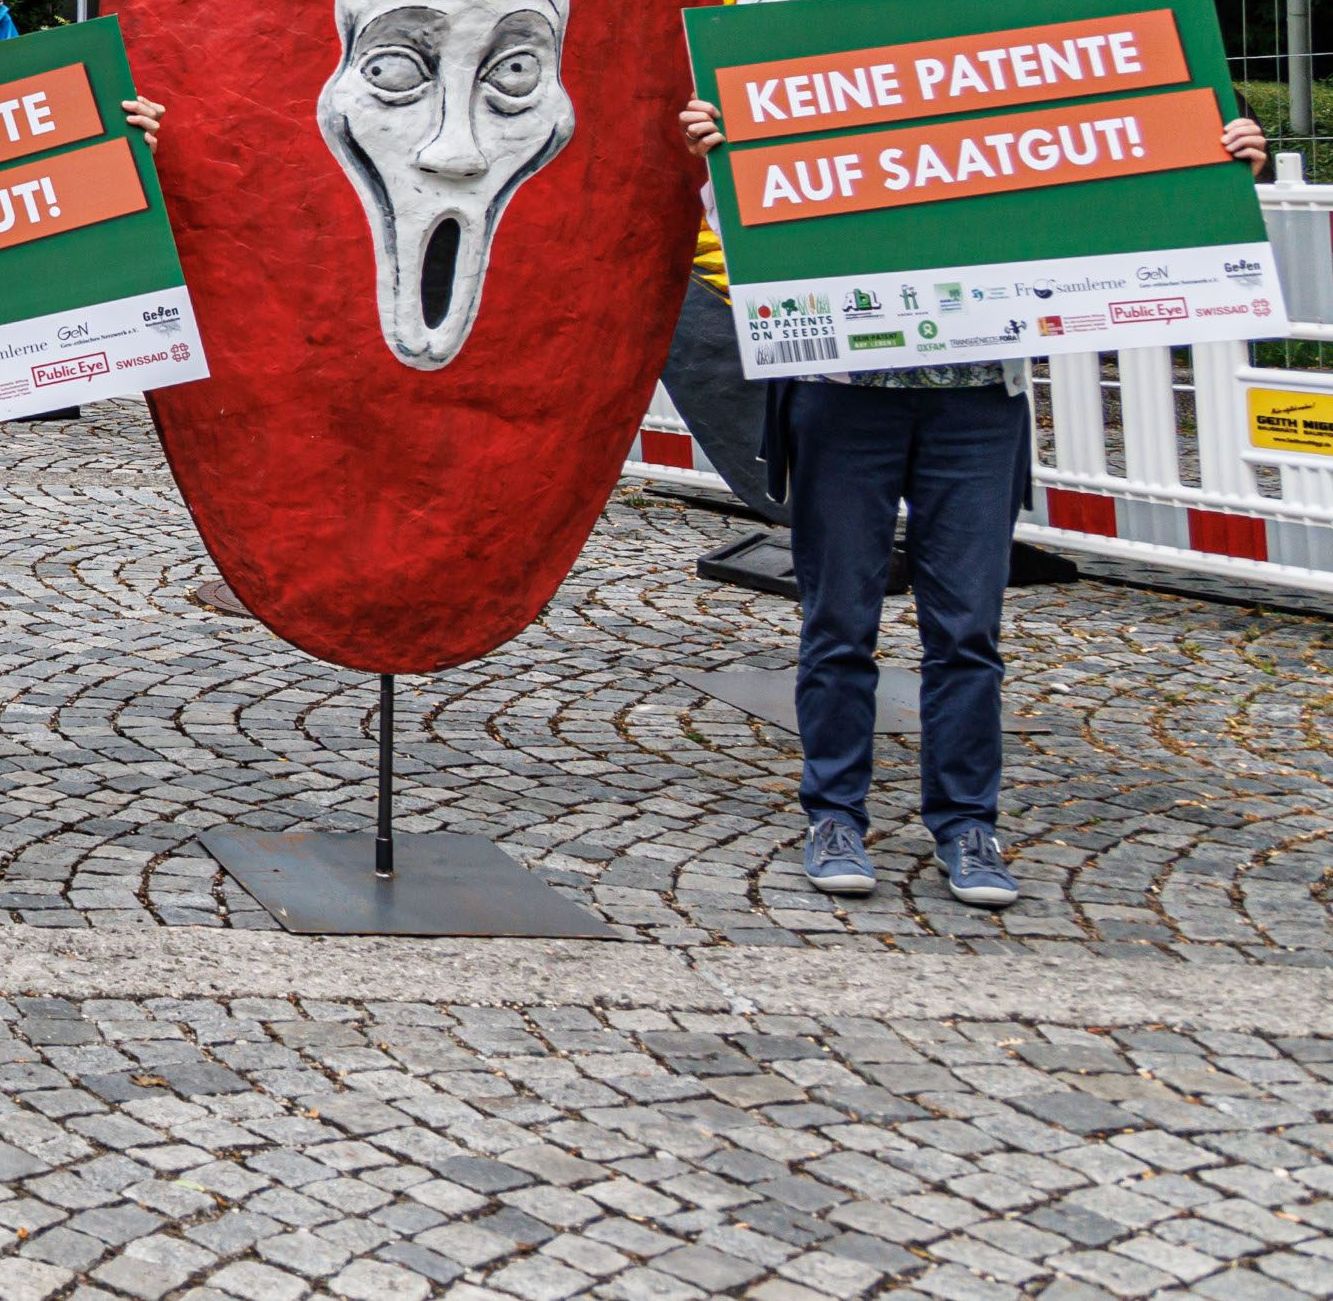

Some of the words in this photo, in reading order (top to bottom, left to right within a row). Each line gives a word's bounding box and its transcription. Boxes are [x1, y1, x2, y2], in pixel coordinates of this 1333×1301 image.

[746, 63, 902, 123] KEINE
[914, 31, 1142, 101] PATENTE
[762, 154, 863, 207] AUF
[879, 116, 1145, 190] SAATGUT!
[1114, 306, 1154, 319] Public
[1157, 304, 1182, 317] Eye
[1195, 305, 1248, 317] SWISSAID
[749, 320, 769, 330] NO
[775, 315, 833, 329] PATENTS
[751, 331, 773, 341] ON
[784, 326, 835, 339] SEEDS!
[917, 343, 946, 353] OXFAM
[116, 351, 168, 370] SWISSAID
[37, 366, 77, 382] Public
[78, 360, 103, 373] Eye
[1256, 415, 1298, 427] GEITH
